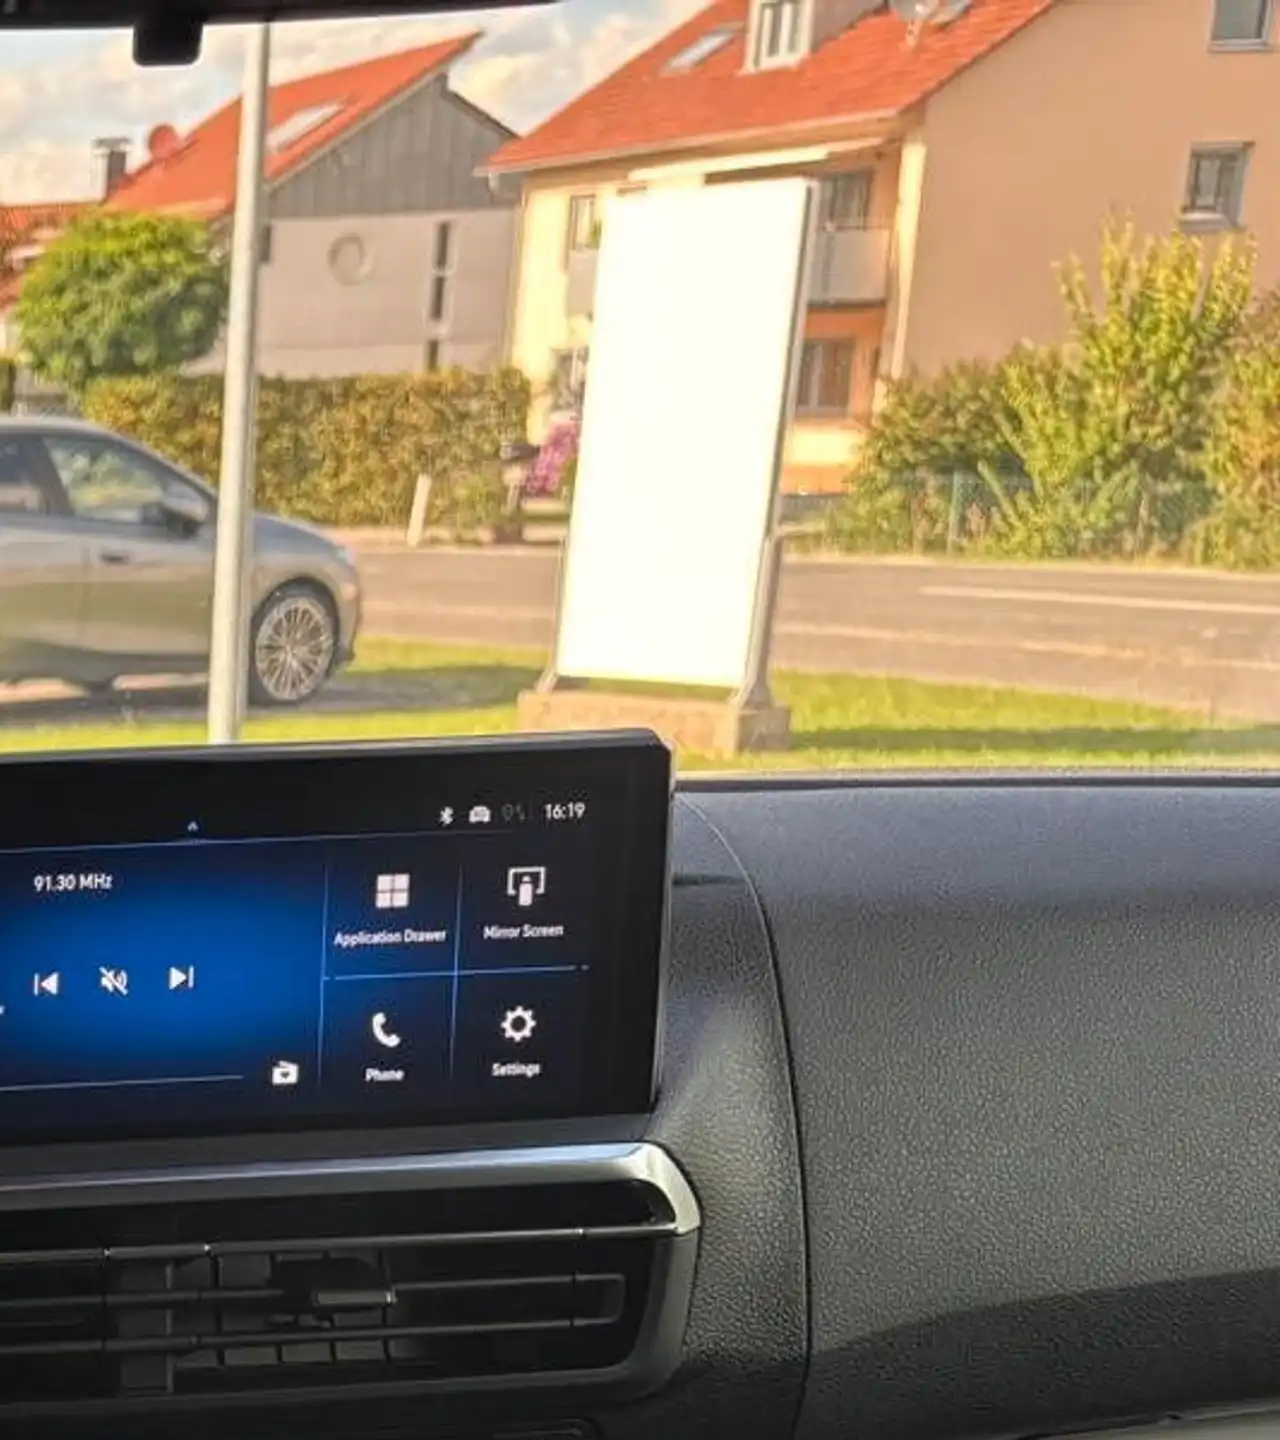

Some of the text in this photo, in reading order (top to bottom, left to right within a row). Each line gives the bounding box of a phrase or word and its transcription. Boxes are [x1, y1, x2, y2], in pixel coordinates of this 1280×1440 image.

[544, 801, 586, 820] 16:19
[33, 872, 114, 892] 91.30 MHz
[333, 928, 447, 948] Application Drawer
[483, 923, 564, 940] Mirror Screen
[364, 1067, 406, 1082] Phone
[492, 1062, 541, 1078] Settings
